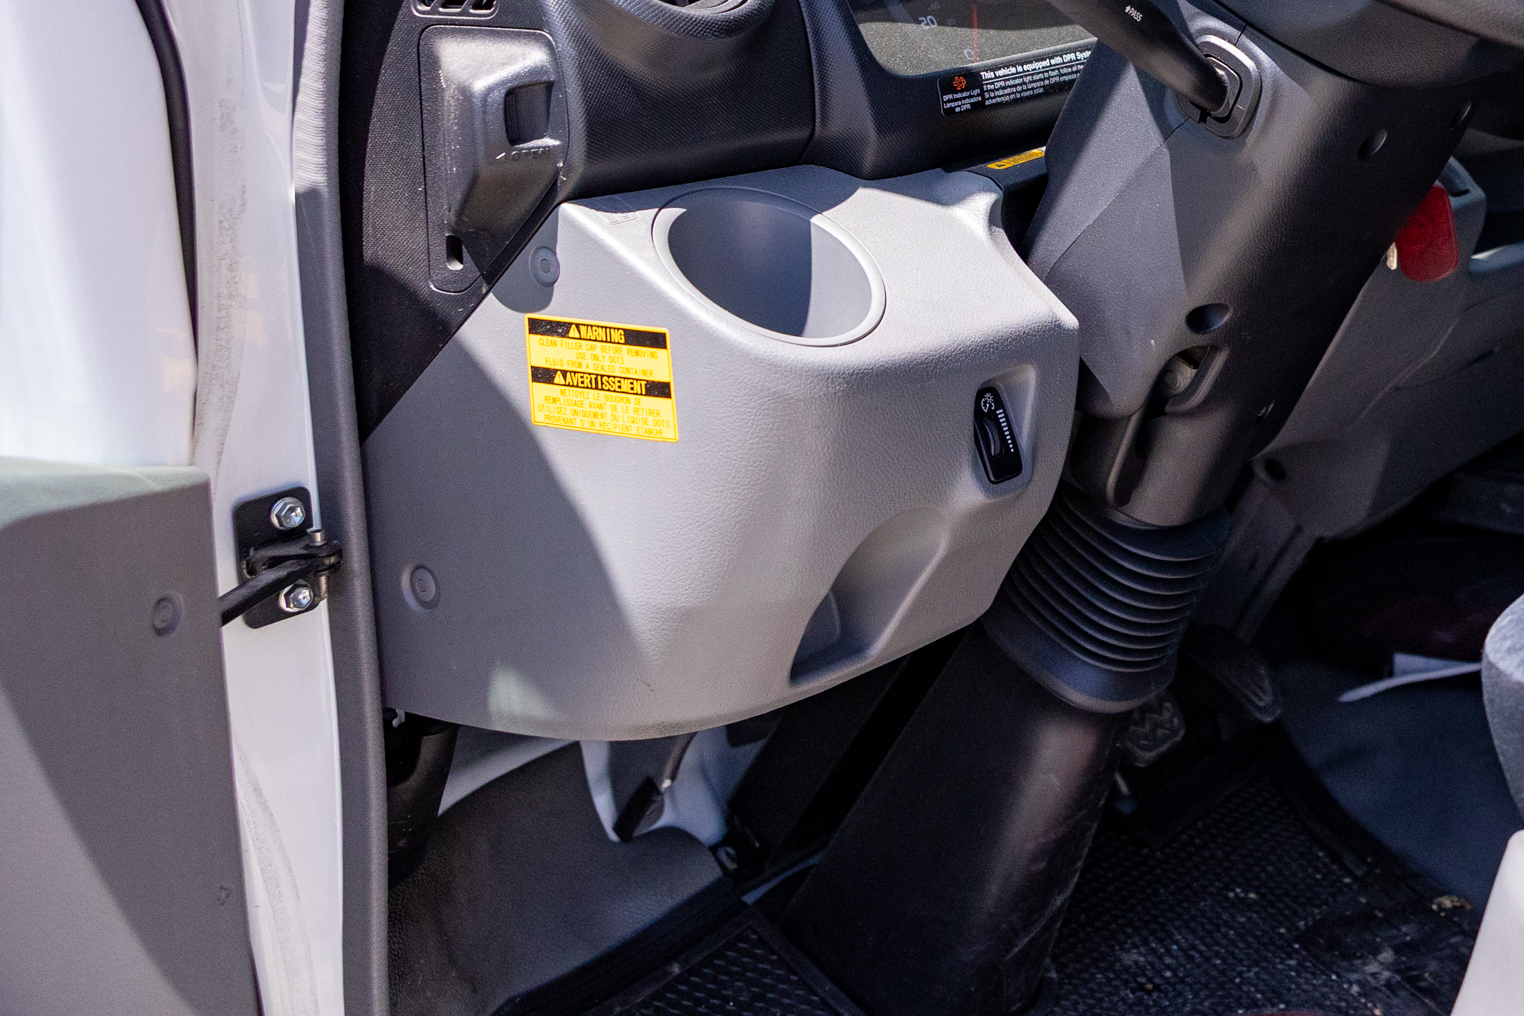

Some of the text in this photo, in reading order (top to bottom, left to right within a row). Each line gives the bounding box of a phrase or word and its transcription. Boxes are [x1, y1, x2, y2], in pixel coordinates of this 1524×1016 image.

[918, 15, 938, 29] 20
[1128, 8, 1143, 22] PASS
[980, 70, 994, 81] This
[995, 65, 1016, 77] vehicle
[1016, 64, 1023, 73] is
[1023, 58, 1050, 73] equipped
[1050, 55, 1063, 66] with
[1063, 52, 1076, 63] DPR
[994, 81, 1005, 89] DPR
[1005, 77, 1023, 86] indicator
[1023, 75, 1032, 84] light
[995, 86, 1016, 97] indicadora
[1049, 76, 1060, 84] DPR
[943, 93, 953, 101] DPR
[970, 87, 980, 97] Light
[961, 95, 982, 105] indicadora
[579, 325, 625, 344] WARNING
[539, 338, 557, 348] CLEAN
[560, 340, 583, 350] FILLER
[586, 343, 597, 352] CAP
[601, 345, 623, 355] BEFORE
[545, 357, 564, 367] FLUID
[567, 359, 582, 369] FROM
[586, 362, 590, 370] A
[593, 362, 615, 373] SEALED
[575, 351, 624, 365] USE ONLY DOT3
[566, 371, 646, 395] AVERTISSEMENT
[545, 396, 585, 408] REMPLISSAGE
[589, 401, 607, 411] AVANT
[611, 404, 618, 413] DE
[622, 405, 630, 414] LE
[560, 388, 642, 406] NETTOYEZ LE BOUCHON DE
[538, 404, 669, 428] UTILISEZ UNIQUEMENT DU LIQUIDE DOT3
[544, 414, 576, 425] PROVENANT
